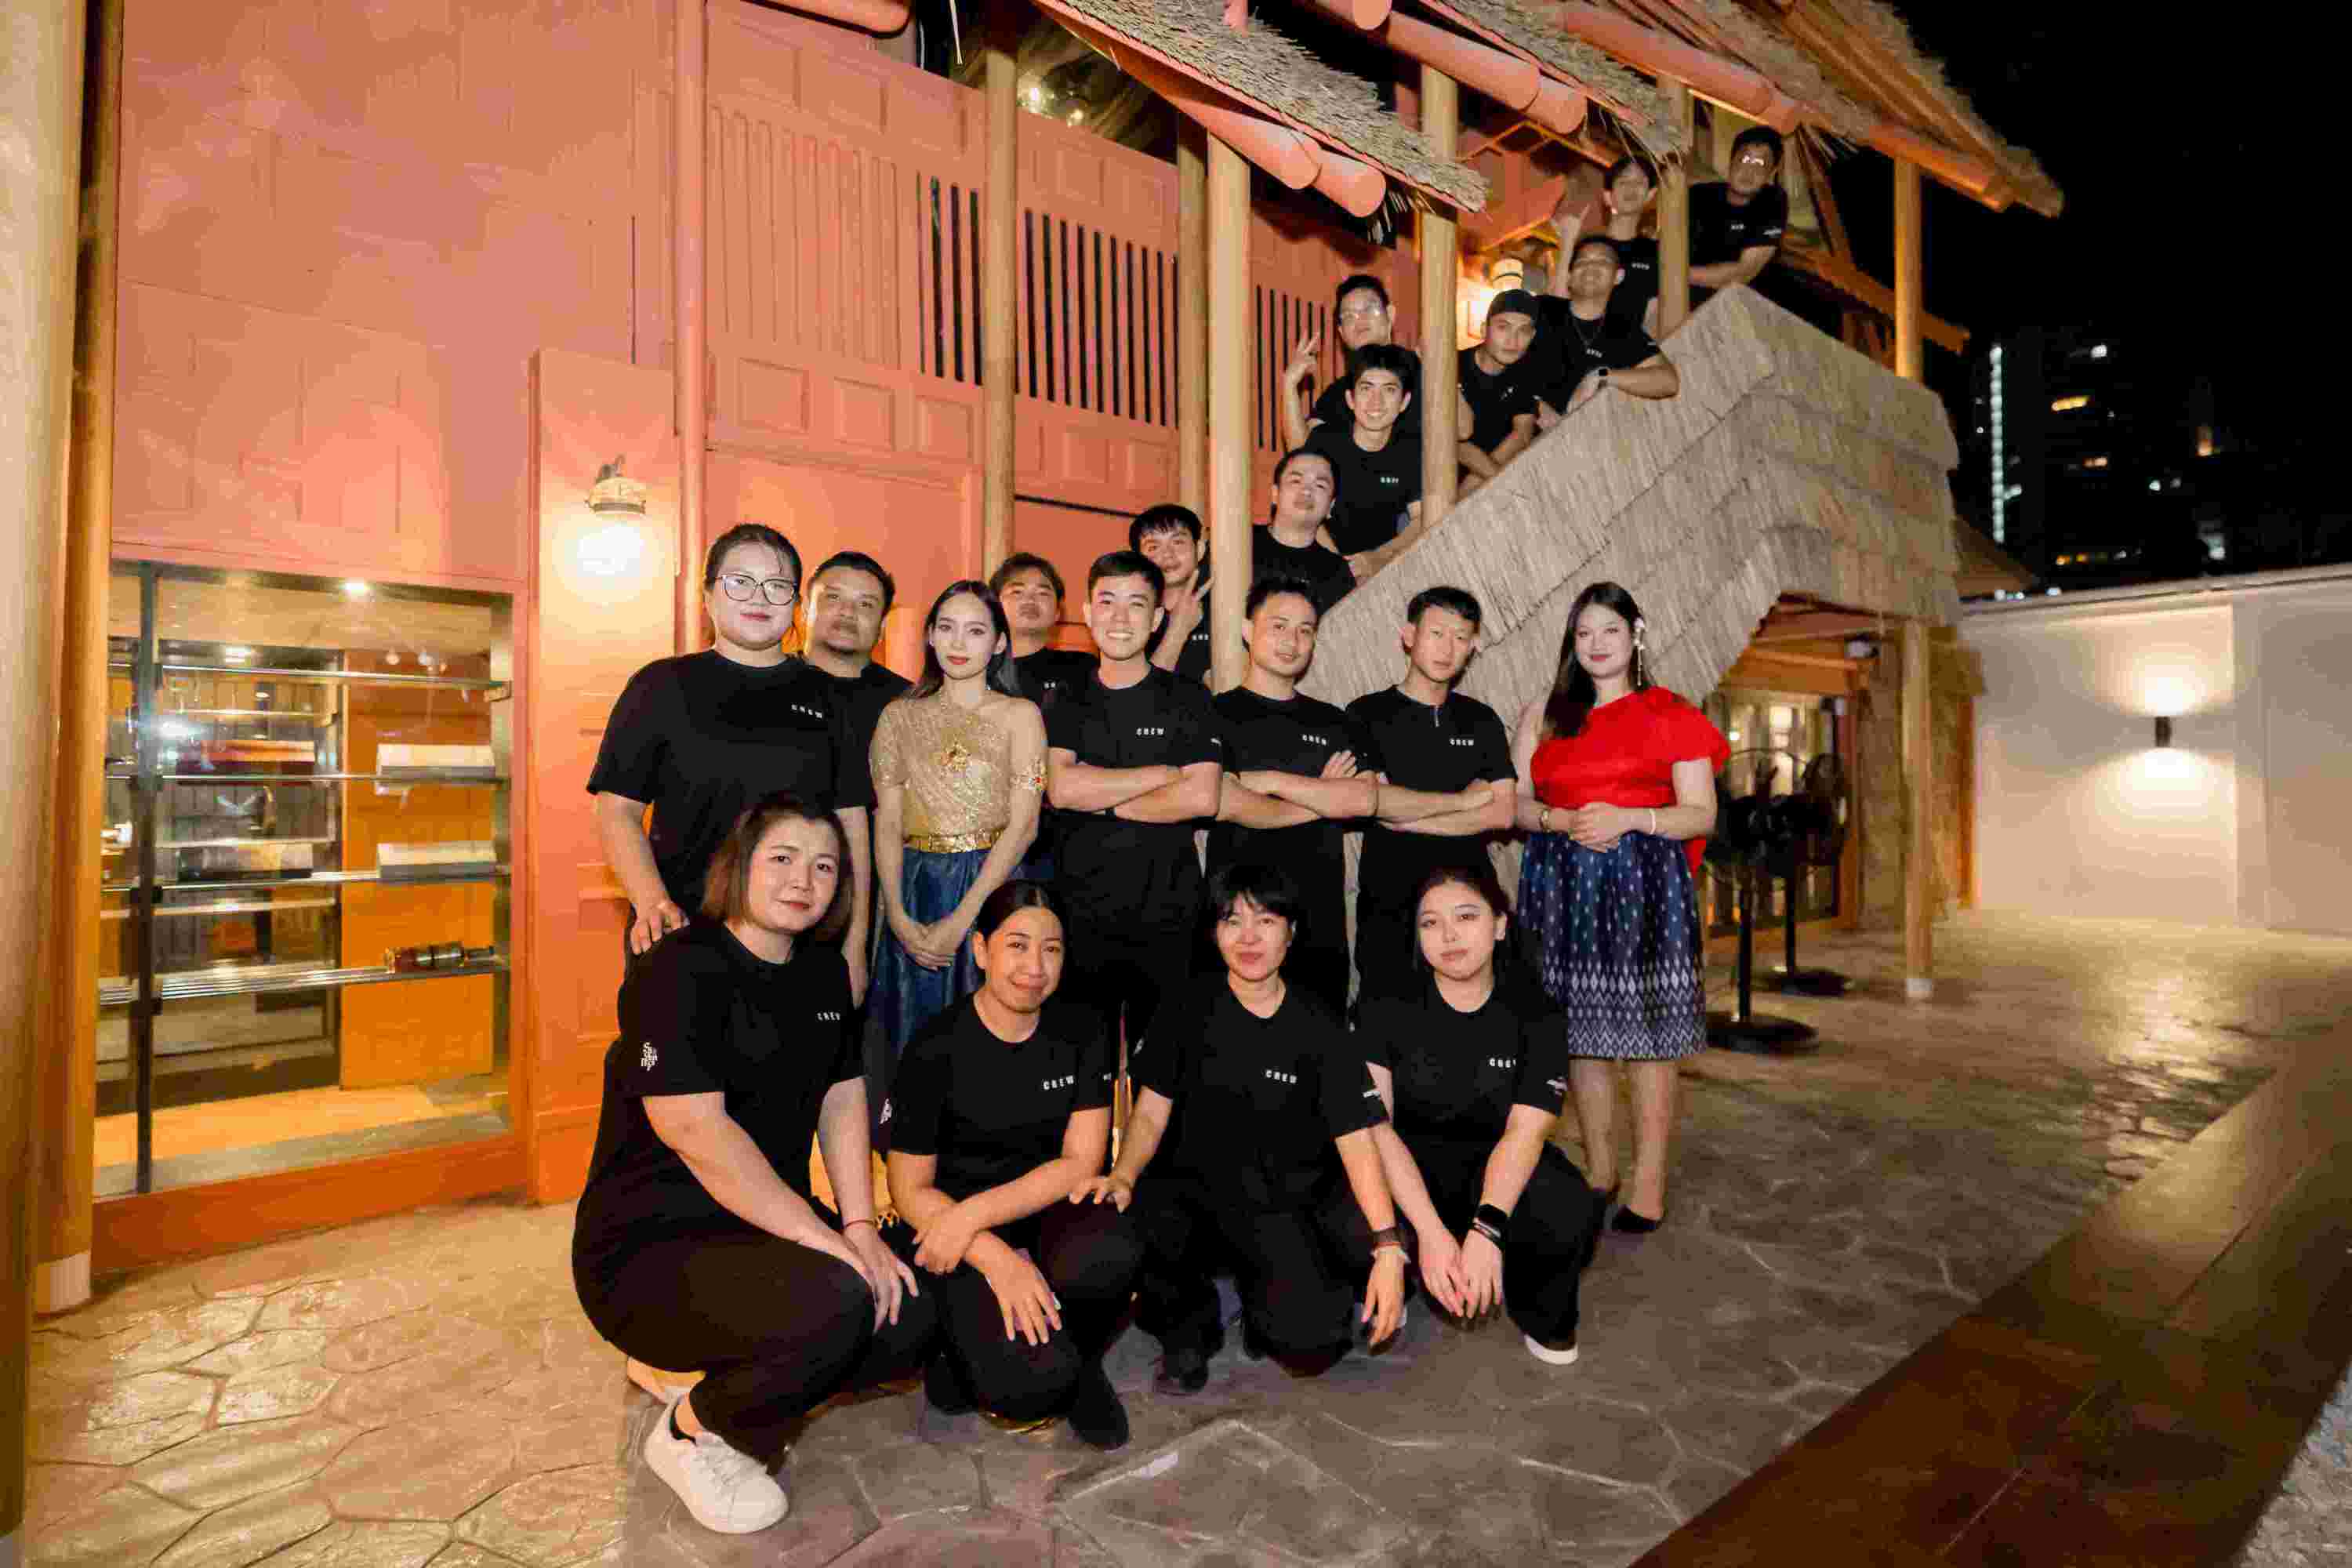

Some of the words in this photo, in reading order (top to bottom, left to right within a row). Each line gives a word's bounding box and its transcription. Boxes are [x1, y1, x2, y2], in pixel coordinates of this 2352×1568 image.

[1136, 727, 1164, 736] CREW
[1044, 1075, 1074, 1091] CREW
[1265, 1069, 1298, 1084] CREW
